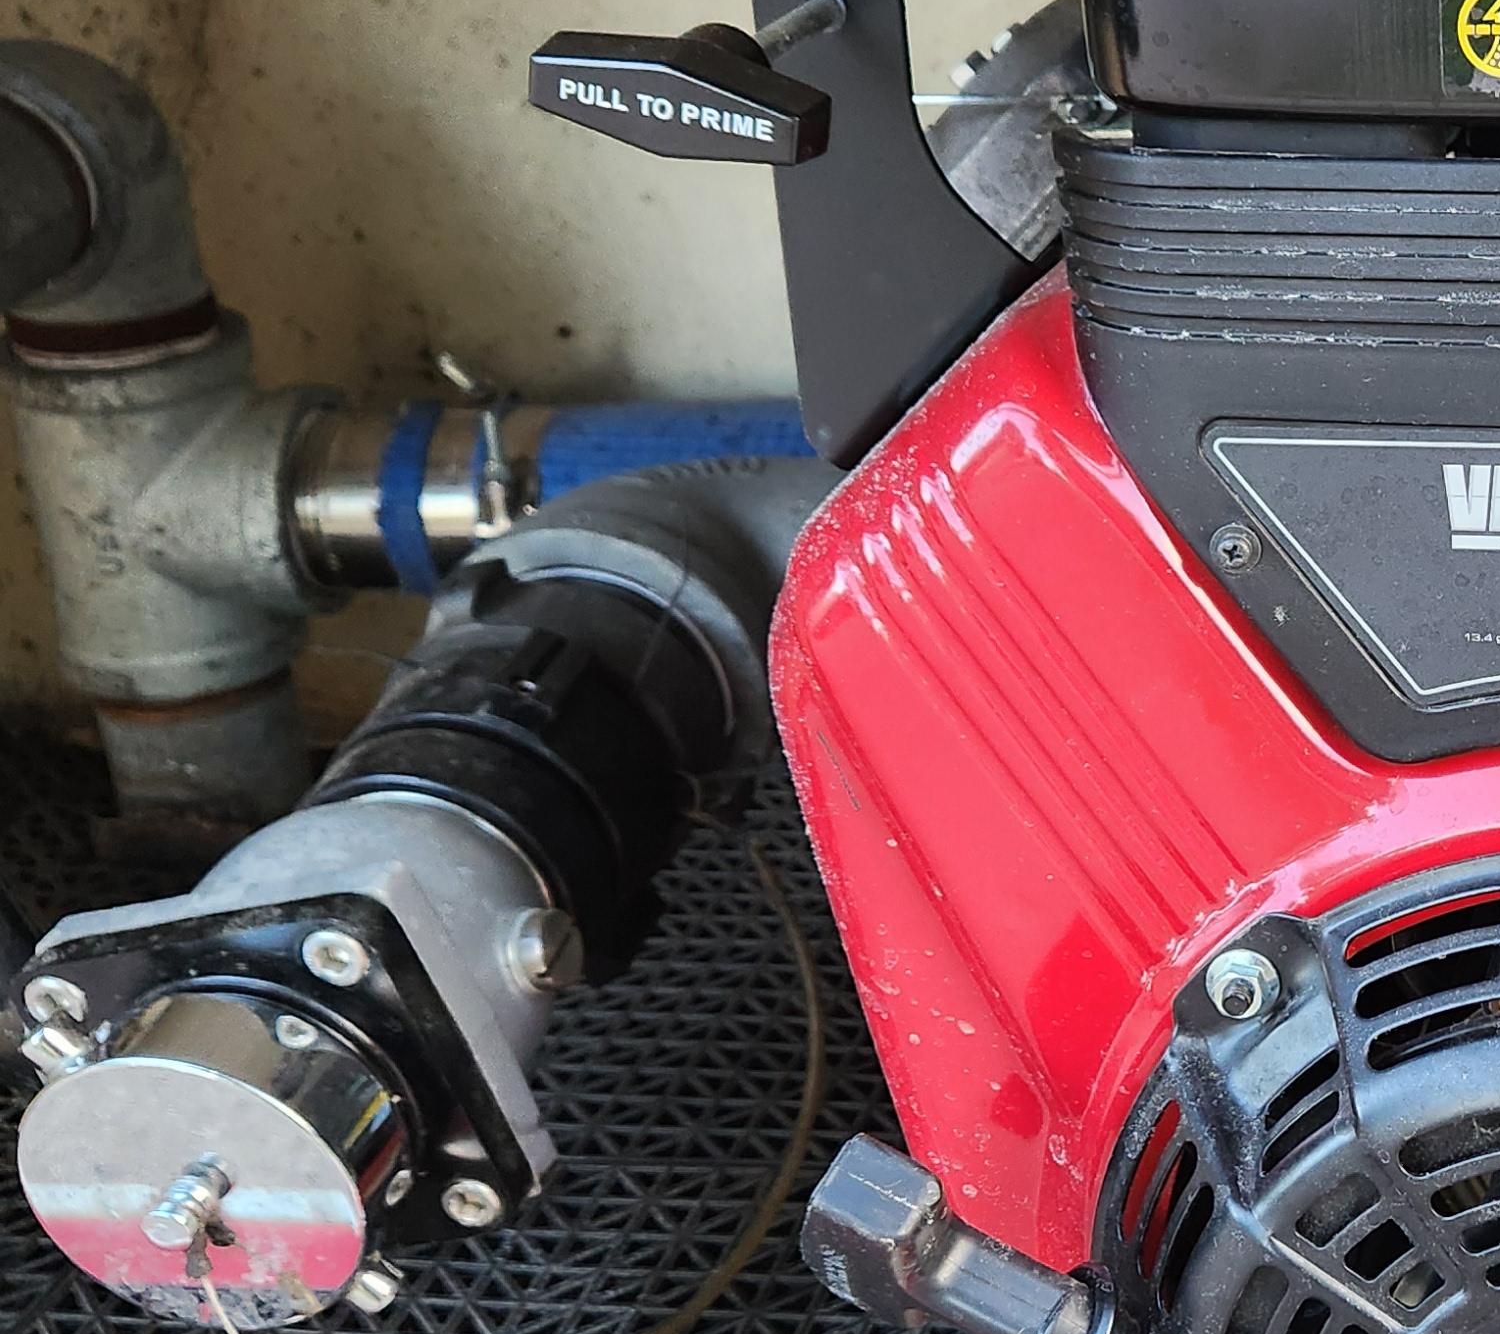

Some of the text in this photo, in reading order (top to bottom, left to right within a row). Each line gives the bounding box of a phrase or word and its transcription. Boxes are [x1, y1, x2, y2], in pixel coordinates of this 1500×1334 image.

[559, 78, 775, 143] PULL TO PRIME
[1464, 633, 1493, 642] 13.4
